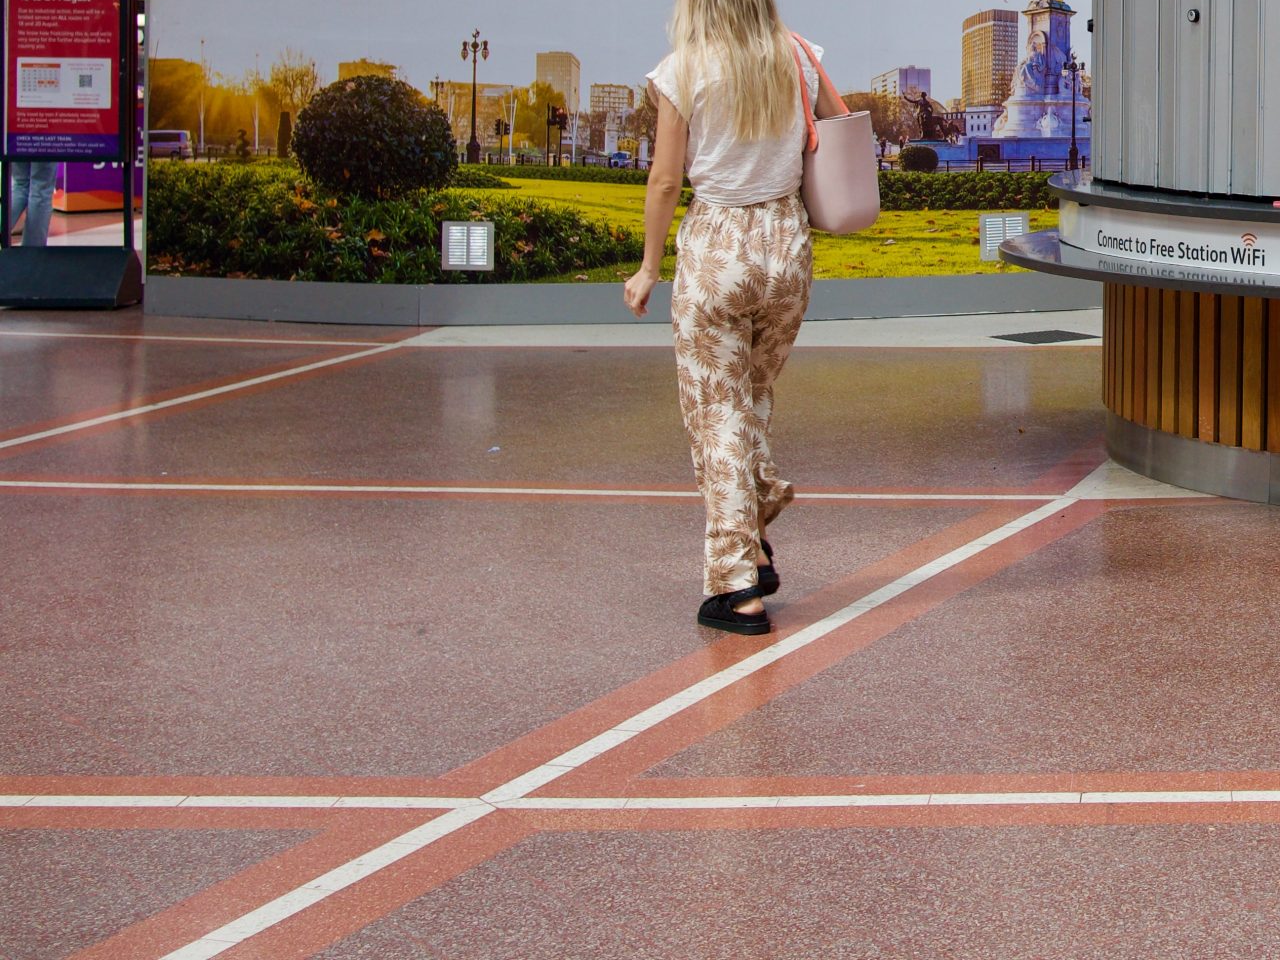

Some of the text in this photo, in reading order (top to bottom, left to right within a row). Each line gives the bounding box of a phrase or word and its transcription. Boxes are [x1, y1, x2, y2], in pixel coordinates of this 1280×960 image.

[1097, 229, 1265, 267] Connect to Free Station WiFi
